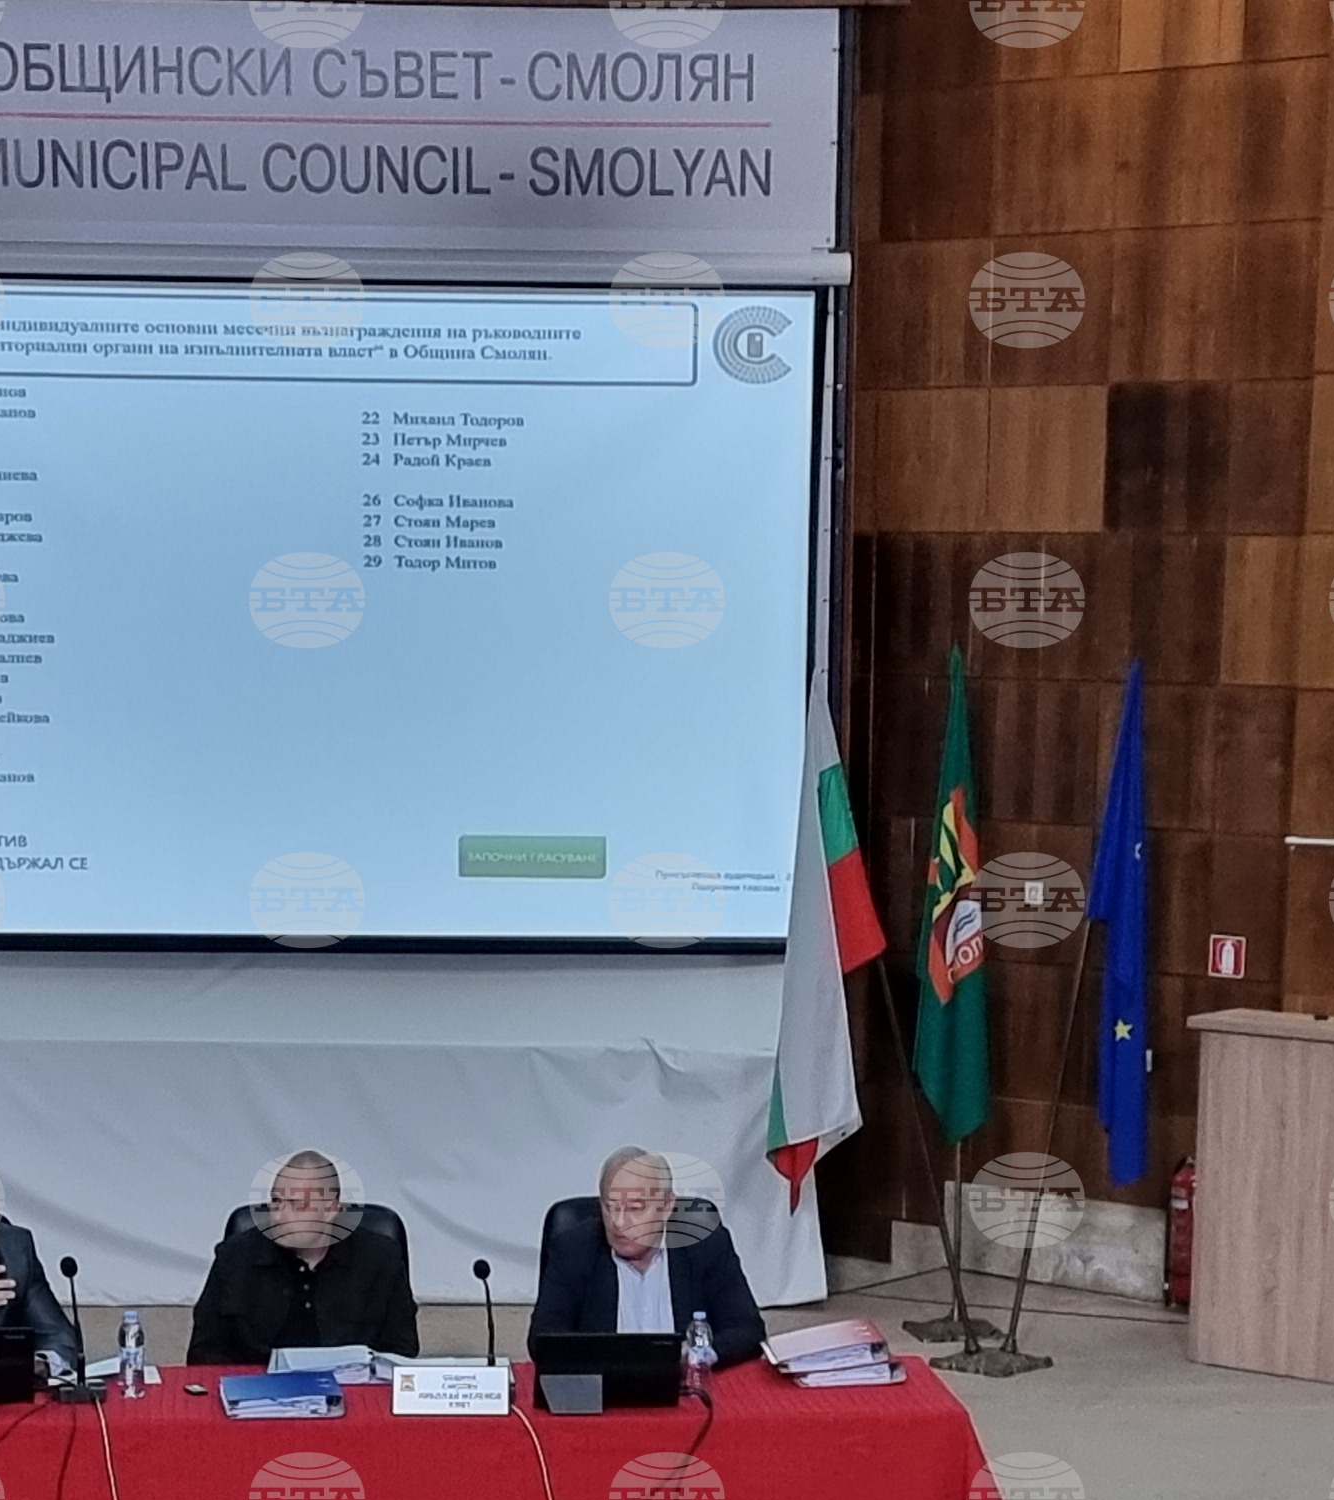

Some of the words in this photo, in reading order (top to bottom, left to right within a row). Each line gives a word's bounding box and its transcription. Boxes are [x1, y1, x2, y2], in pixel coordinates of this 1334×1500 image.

[145, 322, 217, 335] основни
[447, 328, 467, 340] на
[93, 342, 153, 357] органи
[158, 344, 178, 356] на
[389, 348, 399, 359] в
[404, 344, 475, 362] Община
[480, 345, 553, 361] Смолян.
[362, 412, 380, 425] 22
[393, 412, 455, 426] Михаил
[460, 413, 525, 430] Тодоров
[362, 433, 380, 446] 23
[393, 433, 442, 449] Петър
[362, 453, 380, 466] 24
[393, 453, 440, 467] Радой
[445, 454, 492, 470] Краев
[362, 494, 381, 507] 26
[449, 495, 514, 509] Иванова
[363, 515, 381, 527] 27
[394, 515, 441, 529] Стоян
[363, 535, 382, 548] 28
[394, 535, 441, 549] Стоян
[445, 536, 503, 550] Иванов
[363, 555, 382, 568] 29
[394, 555, 441, 572] Тодор
[69, 857, 88, 870] СЕ
